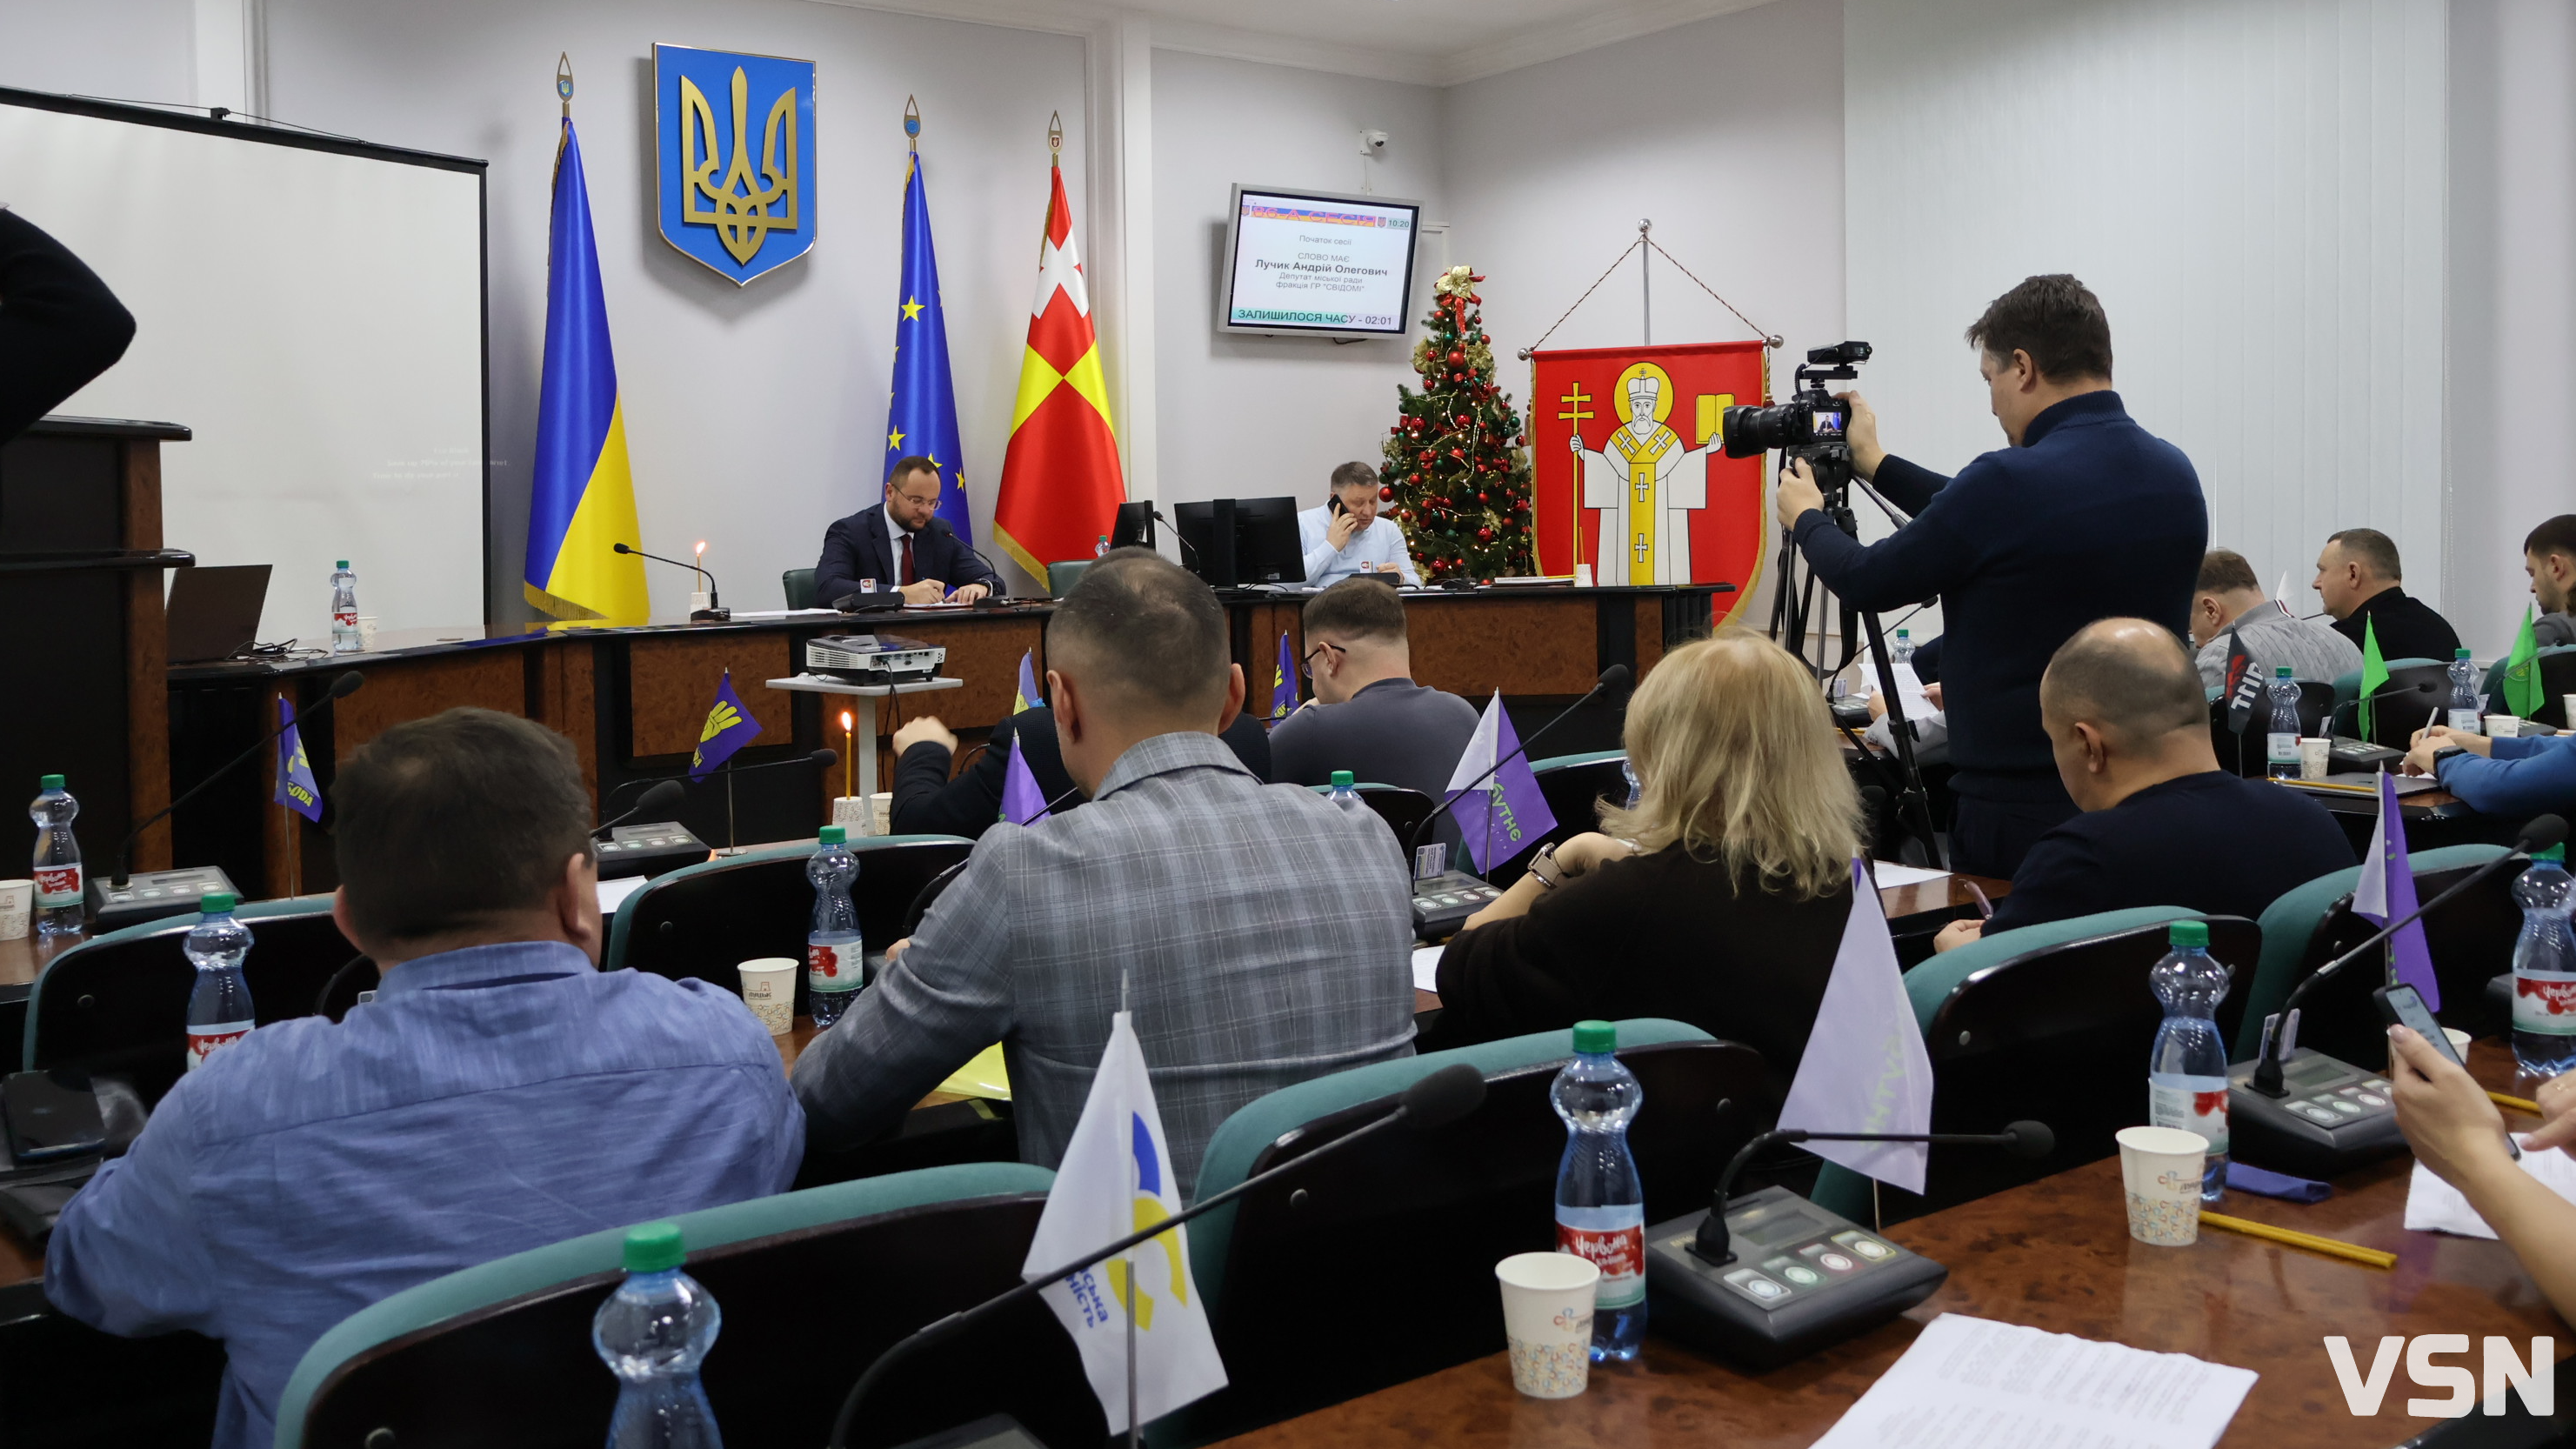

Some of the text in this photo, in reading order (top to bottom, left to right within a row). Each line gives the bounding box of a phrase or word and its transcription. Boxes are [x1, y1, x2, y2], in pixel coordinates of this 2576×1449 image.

[1309, 210, 1377, 227] СЕСІЯ
[1389, 219, 1410, 228] 10:20
[1299, 235, 1332, 244] Початок
[1298, 252, 1329, 261] СЛОВО
[1255, 259, 1388, 277] Лучик Андрій Олегович
[1278, 272, 1311, 281] Депутат
[1238, 310, 1322, 322] ЗАЛИШИЛОСЯ
[1325, 313, 1356, 324] ЧАСУ
[1365, 316, 1392, 325] 02:01
[1575, 1234, 1628, 1259] Червона
